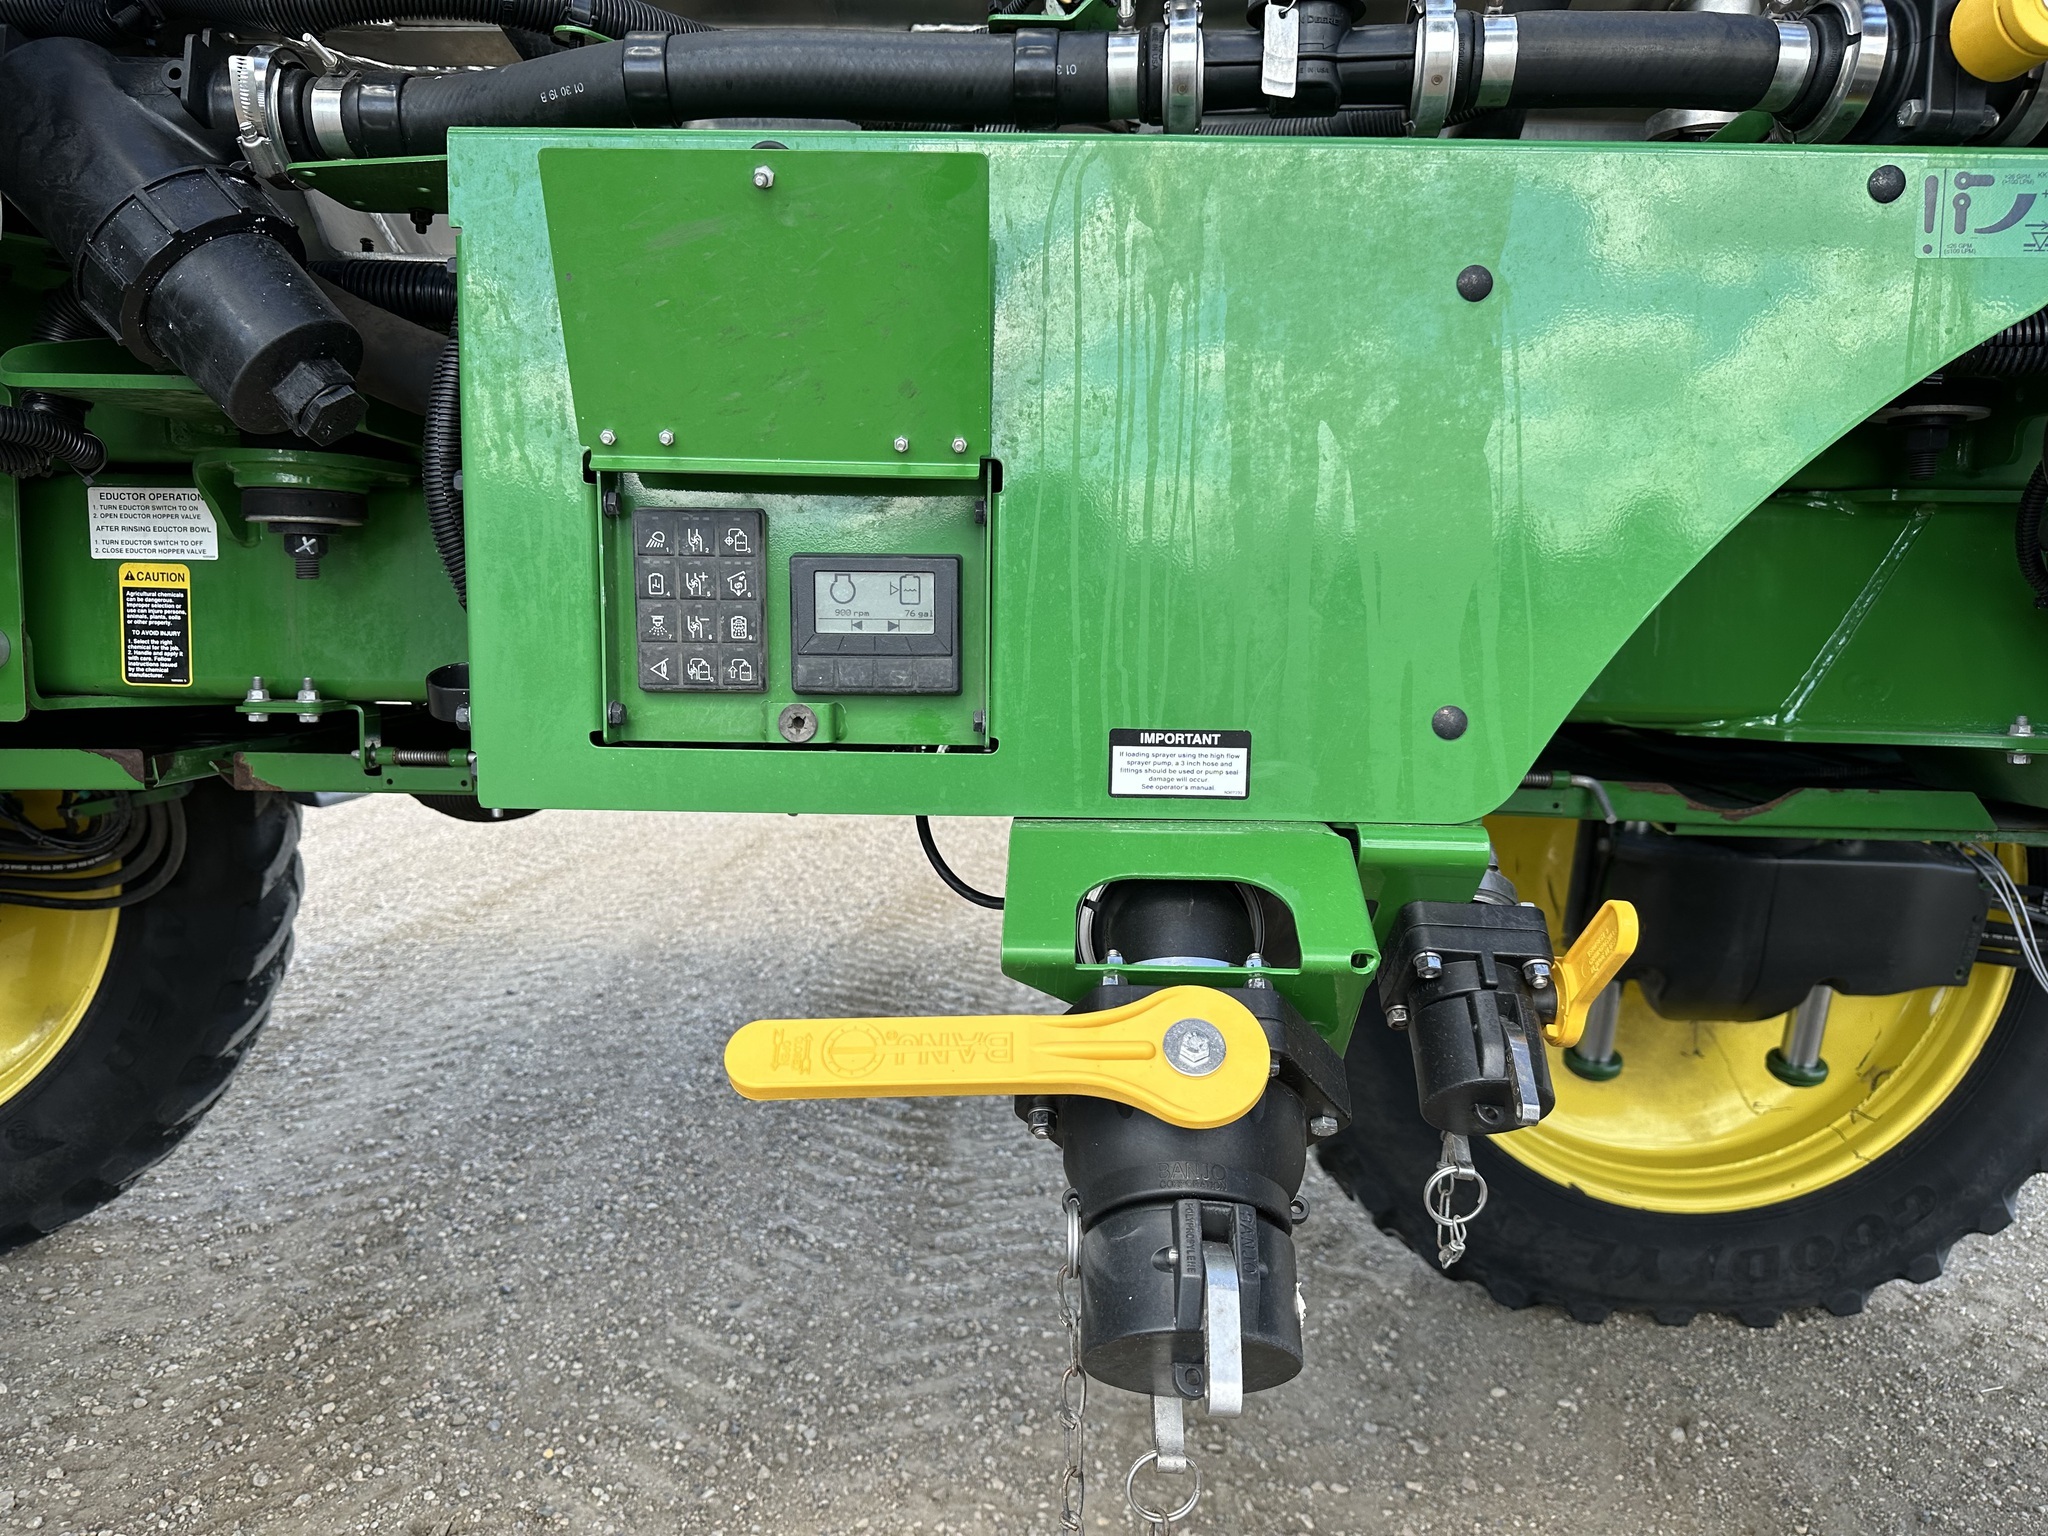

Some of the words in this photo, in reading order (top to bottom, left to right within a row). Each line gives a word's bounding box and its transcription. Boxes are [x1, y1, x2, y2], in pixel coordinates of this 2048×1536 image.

[560, 86, 571, 96] 30
[574, 82, 584, 93] 01
[549, 89, 558, 100] 19
[137, 572, 185, 582] CAUTION
[918, 610, 933, 618] gal
[1140, 733, 1221, 745] IMPORTANT
[1158, 1162, 1227, 1180] BANJO
[1185, 1202, 1196, 1273] POLYPROPYLENE
[1240, 1210, 1258, 1274] BANJO
